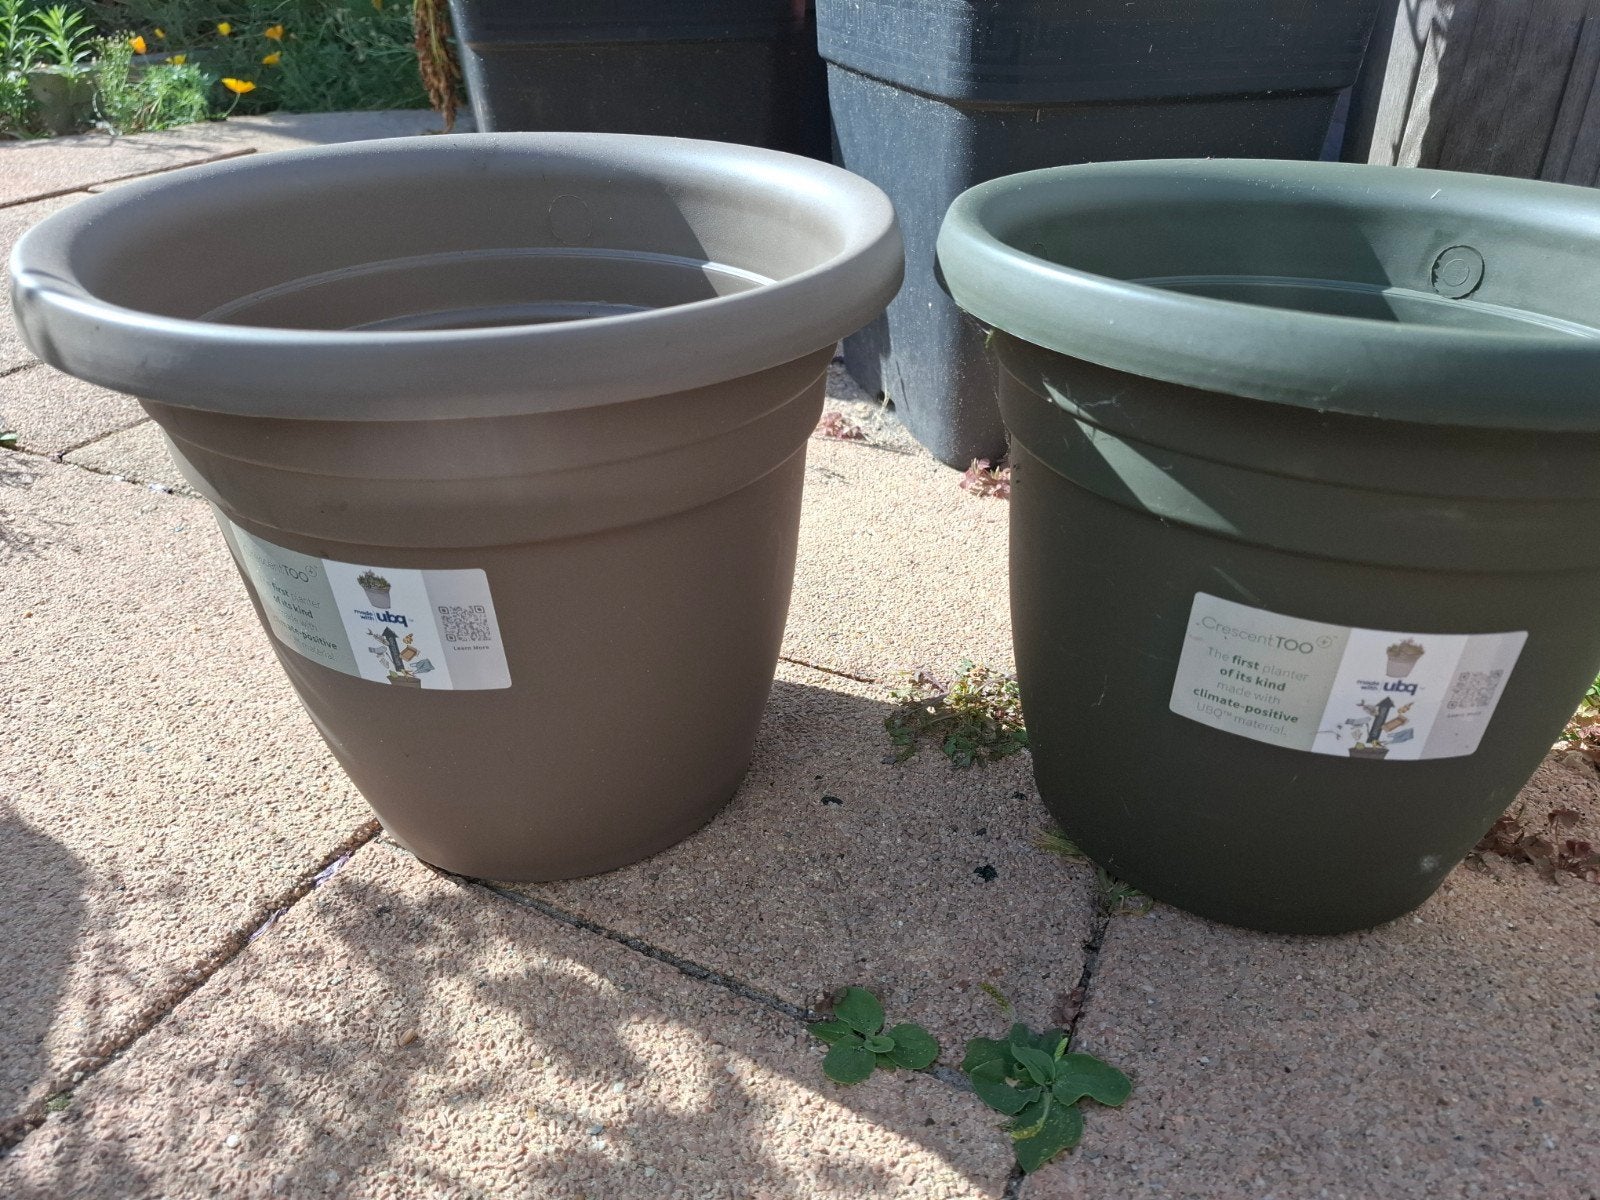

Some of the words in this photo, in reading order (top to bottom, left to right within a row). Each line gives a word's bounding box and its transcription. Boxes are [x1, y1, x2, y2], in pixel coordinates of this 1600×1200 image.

[292, 603, 314, 619] kind
[376, 610, 408, 628] ubq
[1201, 616, 1314, 654] CrescentTOO
[1208, 646, 1229, 660] The
[1232, 654, 1260, 670] first
[1262, 664, 1310, 681] planter
[1220, 668, 1234, 677] of
[1236, 670, 1252, 683] its
[1255, 676, 1287, 692] kind
[1382, 680, 1418, 696] ubq
[1193, 687, 1299, 723] climate-positive
[1216, 681, 1252, 697] made
[1253, 692, 1281, 705] with
[1234, 715, 1287, 736] material.
